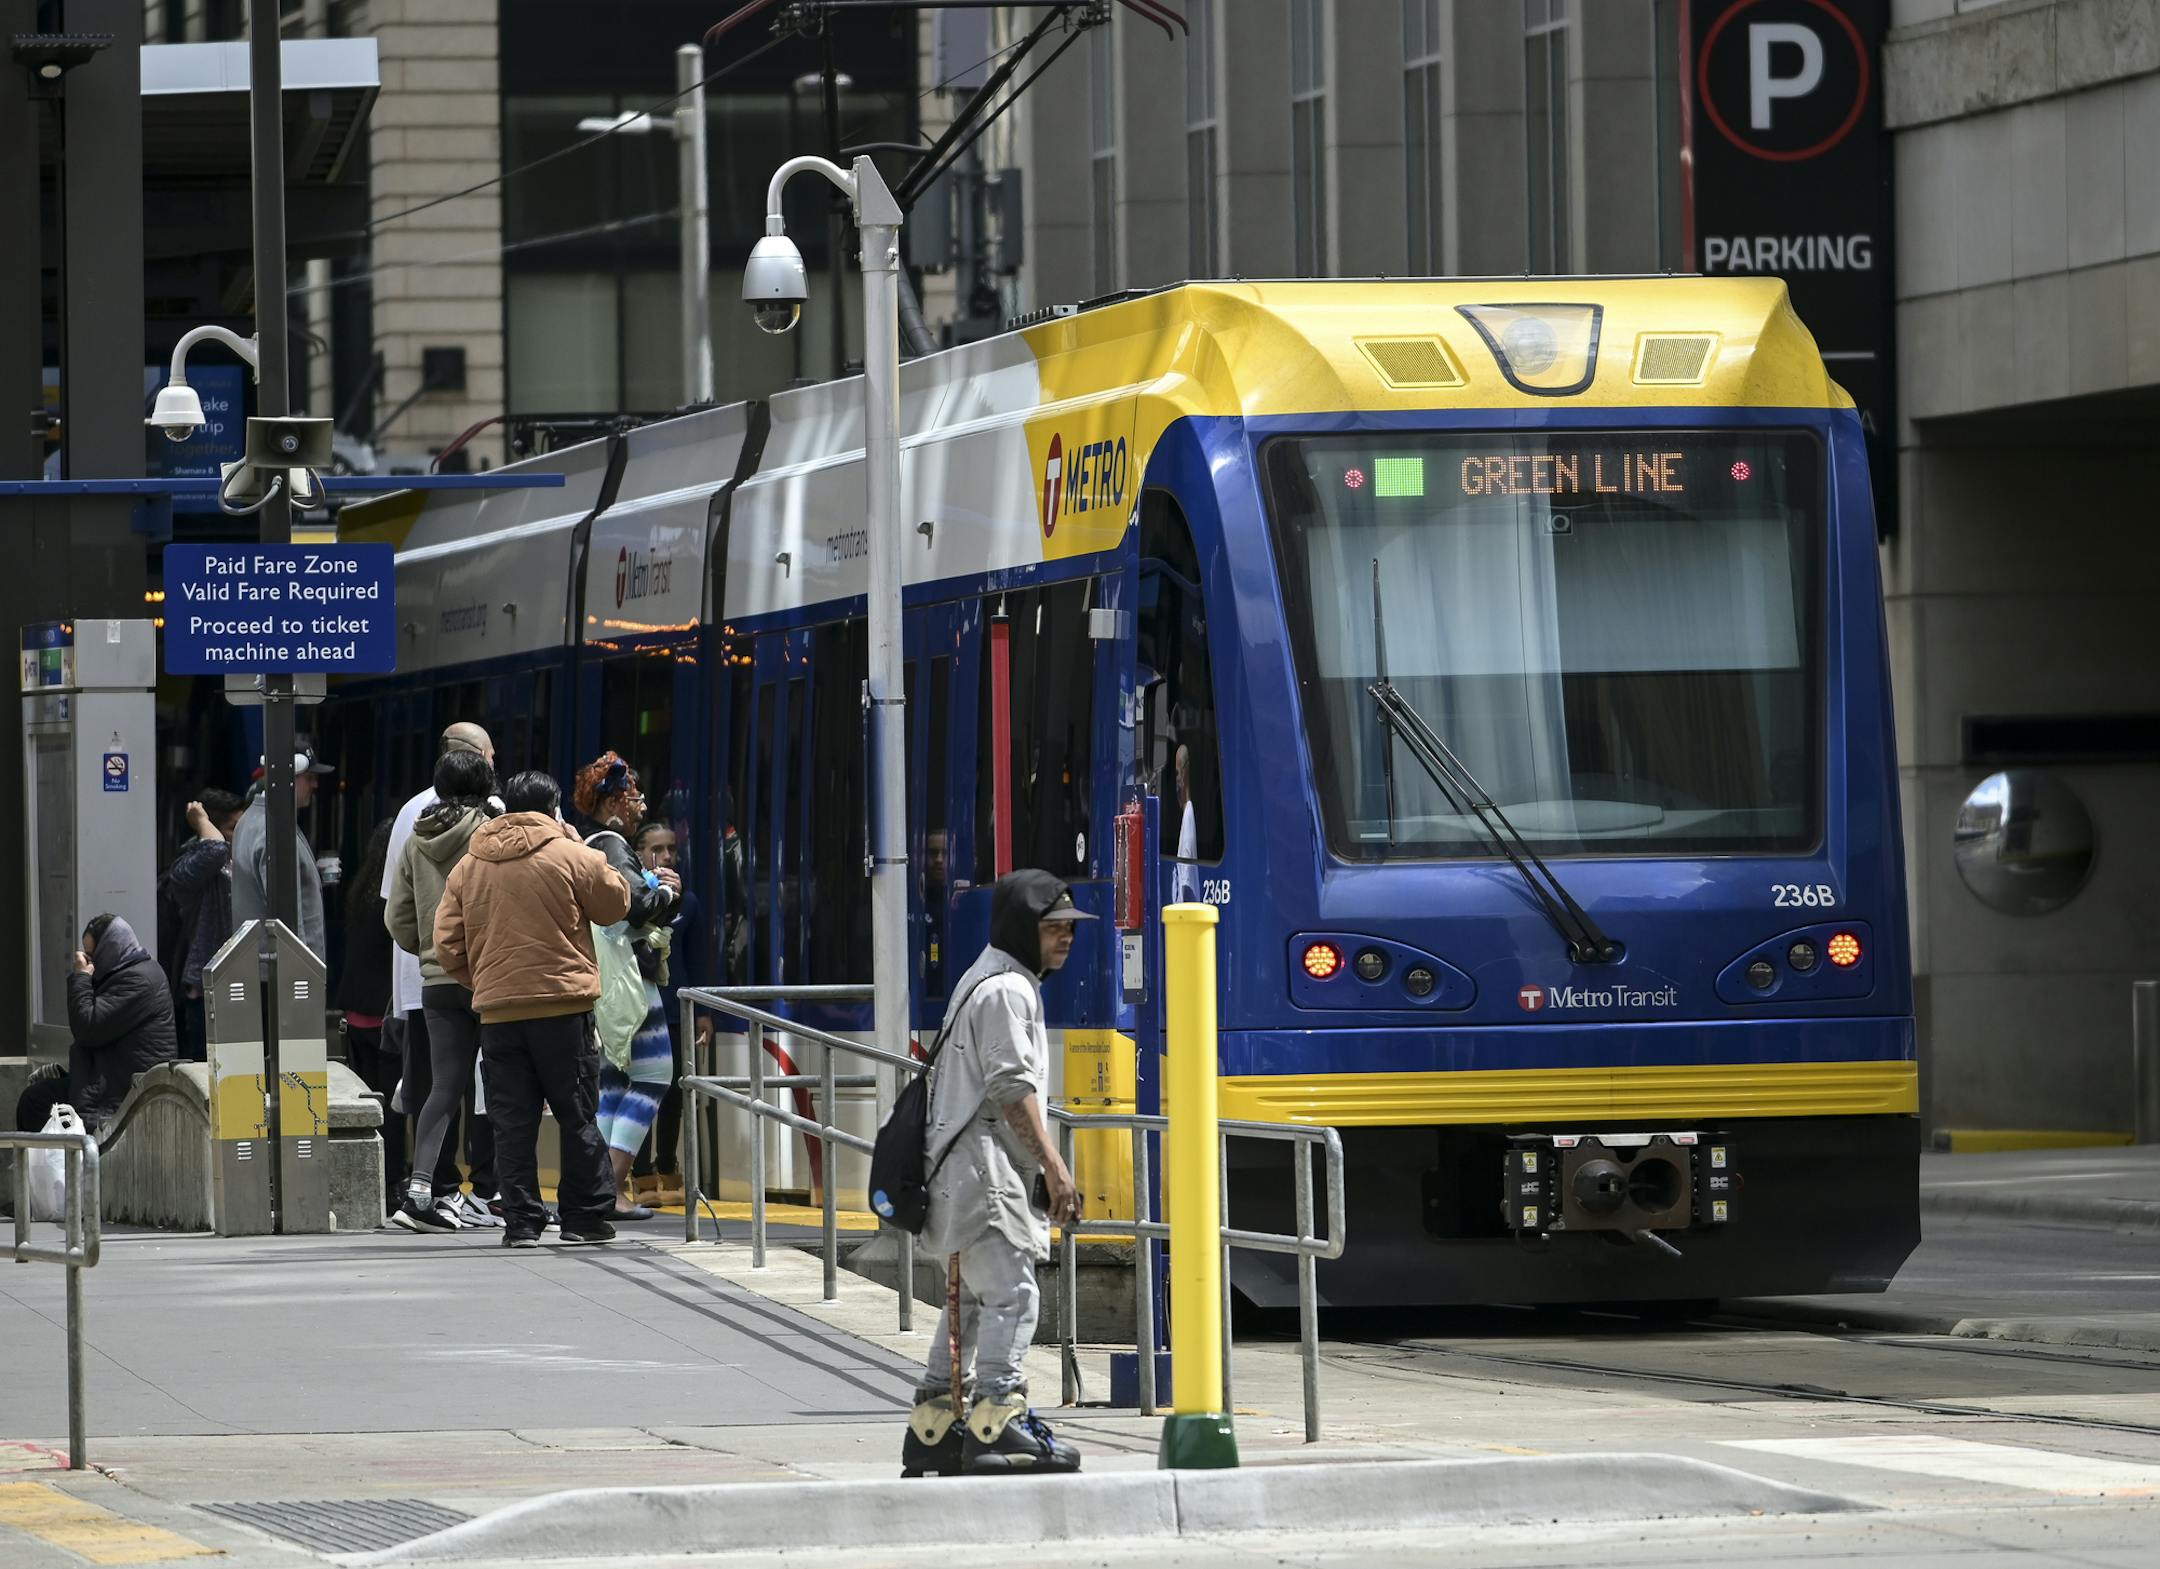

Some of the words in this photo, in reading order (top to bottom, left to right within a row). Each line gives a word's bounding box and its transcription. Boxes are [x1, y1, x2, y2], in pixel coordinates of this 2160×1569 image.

[1749, 23, 1823, 129] P
[1704, 235, 1871, 271] PARKING
[202, 396, 229, 411] ake
[200, 420, 224, 436] trip
[1064, 436, 1126, 516] METRO
[1461, 456, 1580, 495] GREEN
[1595, 453, 1684, 493] LINE
[825, 526, 869, 564] metrotrans
[205, 556, 245, 575] Paid
[254, 556, 297, 574] Fare
[304, 555, 358, 574] Zone
[182, 582, 230, 601] Valid
[238, 582, 281, 601] Fare
[289, 581, 379, 605] Required
[190, 615, 273, 635] Proceed
[281, 616, 303, 634] to
[311, 615, 370, 634] ticket
[205, 642, 289, 661] machine
[296, 641, 356, 660] ahead
[1202, 879, 1231, 905] 236B
[1771, 884, 1835, 907] 236B
